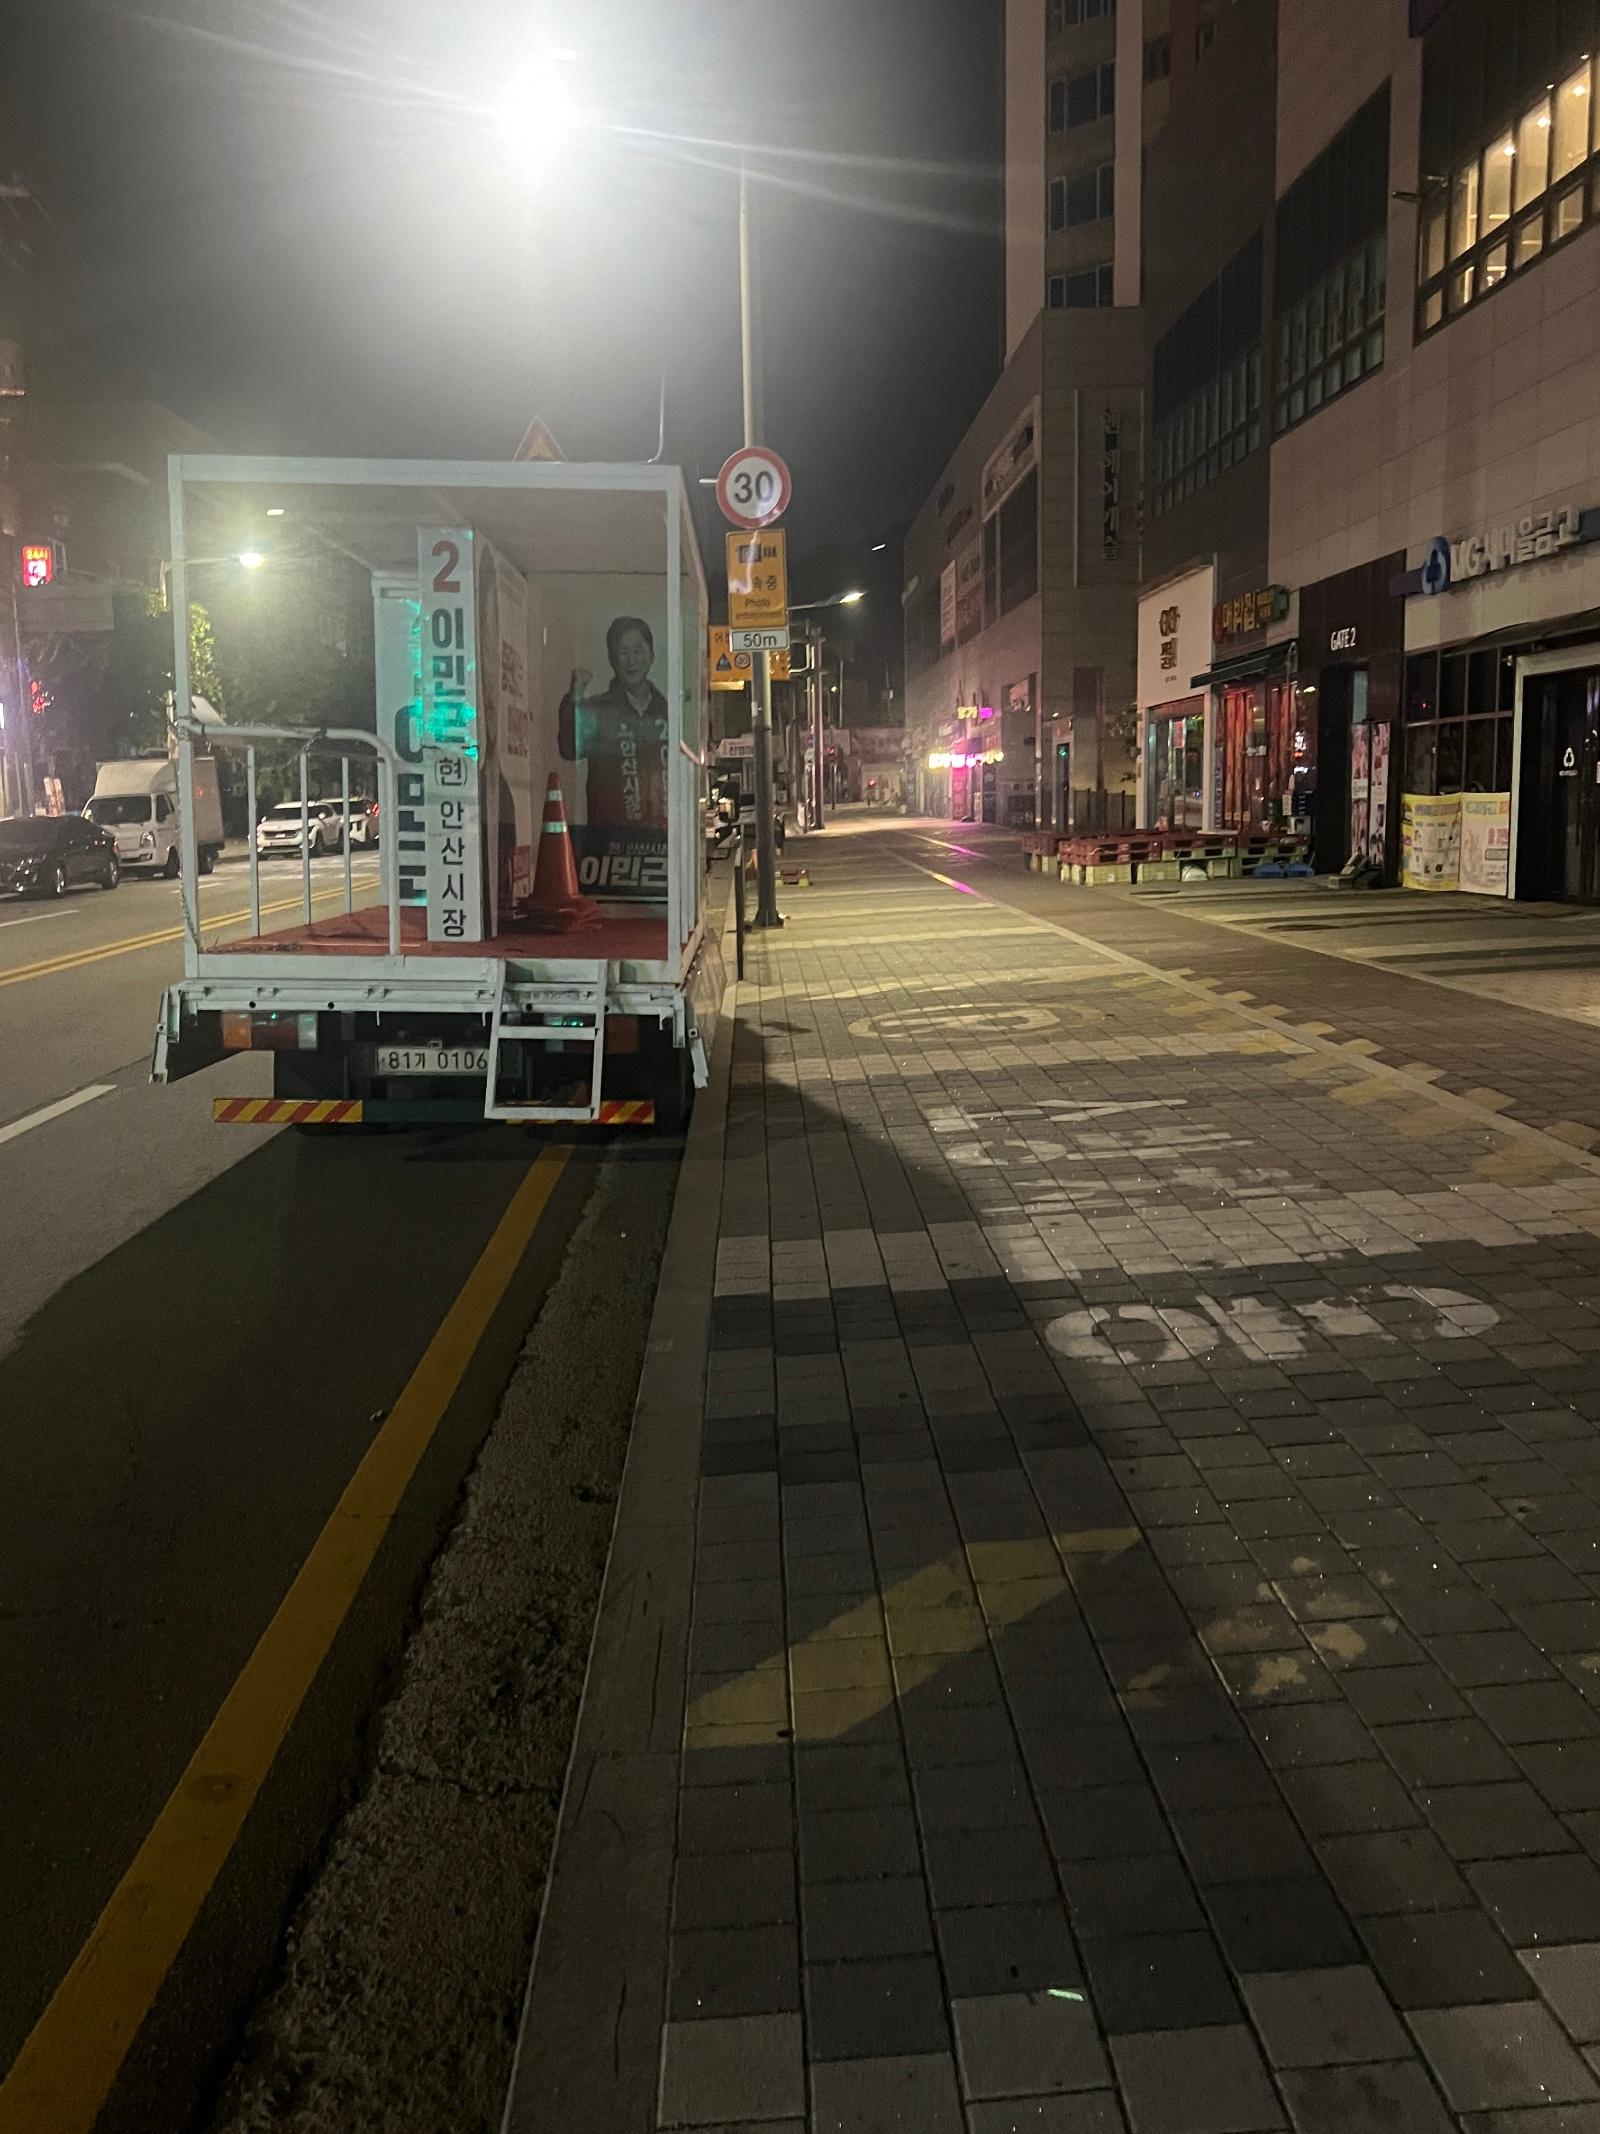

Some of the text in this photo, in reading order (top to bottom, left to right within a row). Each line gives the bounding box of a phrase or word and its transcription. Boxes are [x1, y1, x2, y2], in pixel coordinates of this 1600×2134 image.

[733, 470, 775, 505] 30
[430, 539, 461, 594] 2
[743, 633, 777, 648] 50m
[1330, 627, 1350, 651] GATE
[430, 606, 467, 744] 이민근
[433, 756, 468, 787] (현)
[439, 800, 468, 938] 안산시장
[579, 855, 668, 888] 이민근
[437, 1050, 488, 1070] 0106
